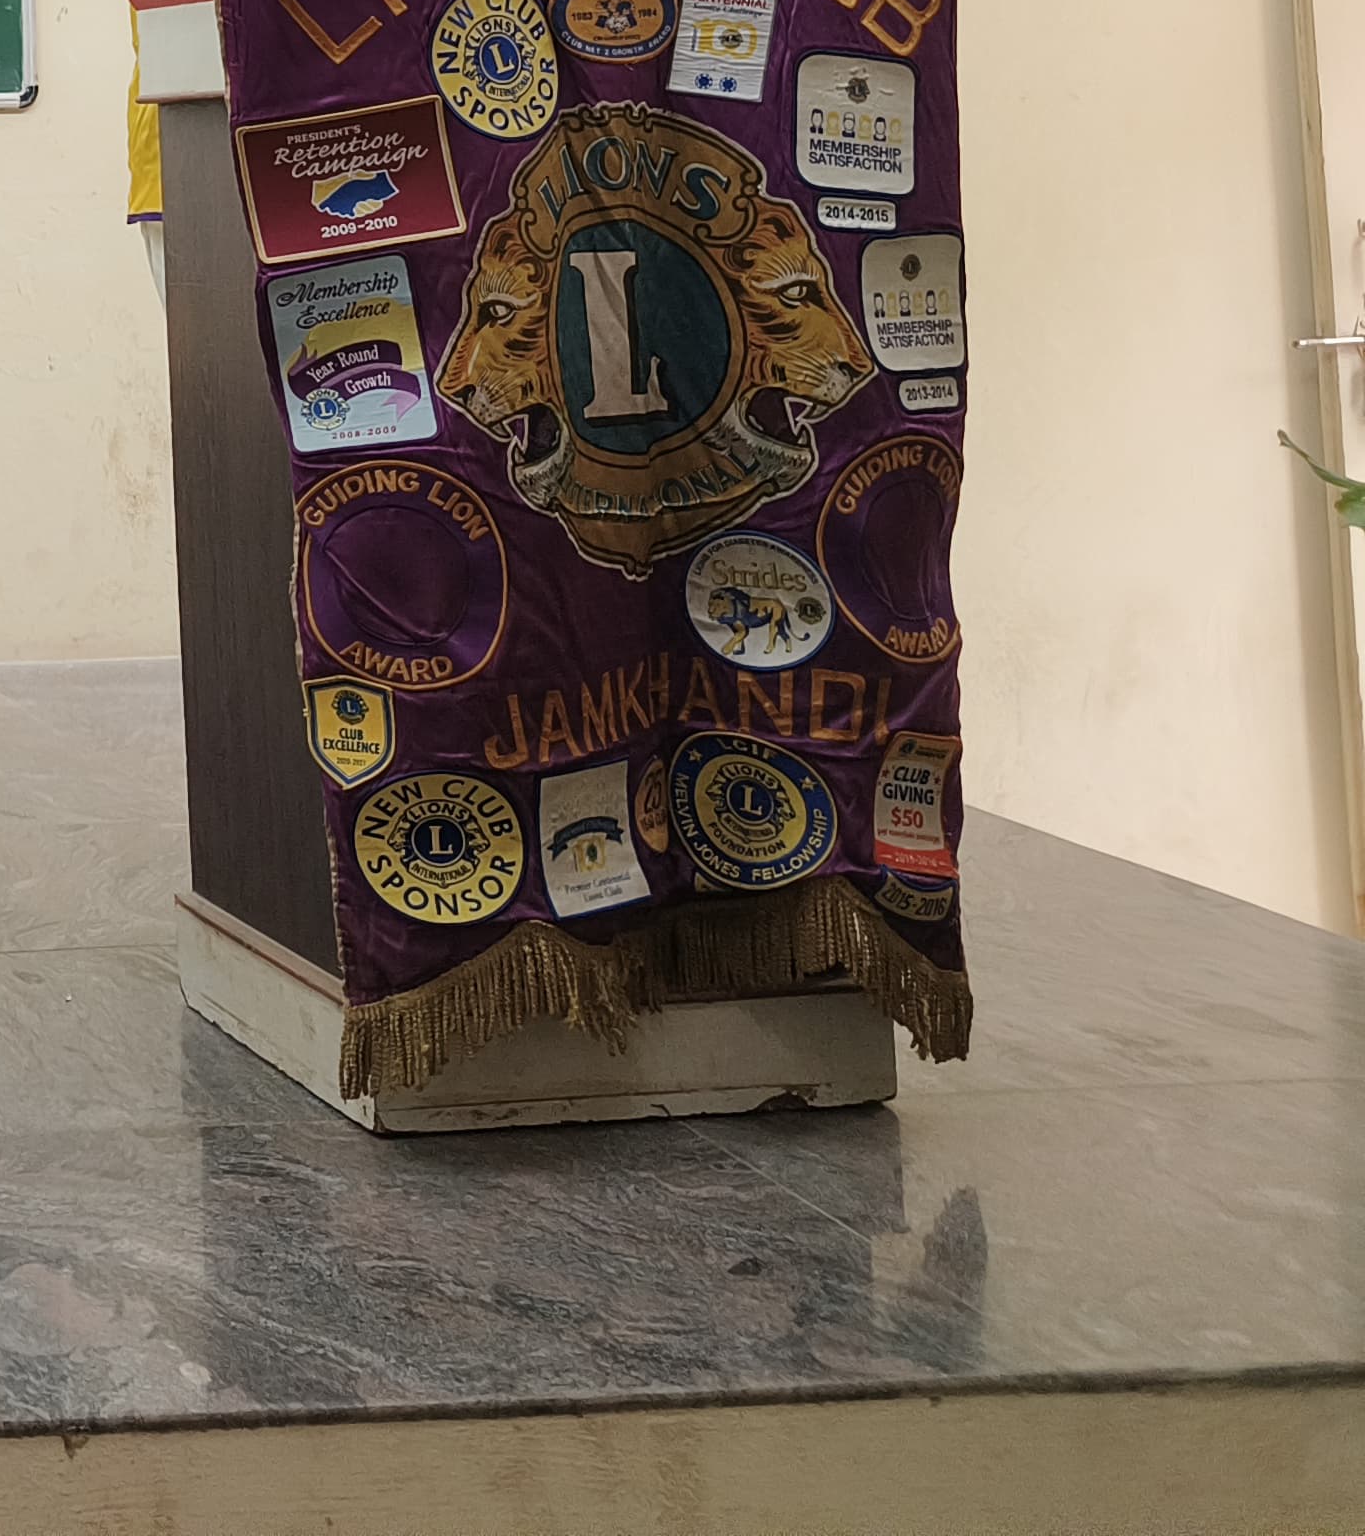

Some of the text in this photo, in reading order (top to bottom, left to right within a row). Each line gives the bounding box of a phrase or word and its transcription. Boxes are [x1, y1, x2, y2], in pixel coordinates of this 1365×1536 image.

[469, 17, 514, 45] LIONS
[488, 41, 516, 76] L
[452, 56, 556, 132] SPONSOR
[273, 130, 406, 166] Retention
[286, 124, 363, 145] PRESIDENT'S
[808, 138, 903, 160] MEMBERSHIP
[290, 144, 429, 179] Campaign
[808, 151, 903, 175] SATISFACTION
[536, 135, 732, 225] LIONS
[320, 215, 399, 240] 2009-2010
[825, 205, 890, 223] 2014-2015
[276, 271, 400, 308] Membership
[295, 300, 391, 330] Excellence
[876, 318, 953, 336] MEMBERSHIP
[569, 249, 671, 424] L
[878, 332, 955, 350] SATISFACTION
[344, 371, 392, 395] Growth
[905, 385, 954, 402] 2013-2014
[319, 402, 333, 417] L
[835, 444, 924, 515] GUIDING
[303, 468, 490, 542] GUIDING LION
[710, 559, 808, 593] Strides
[884, 616, 950, 655] AWARD
[339, 640, 454, 683] AWARD
[345, 699, 356, 713] L
[482, 653, 893, 770] JAMKHANDI
[322, 738, 381, 755] EXCELLENCE
[339, 727, 364, 741] CLUB
[716, 737, 779, 761] LCIF
[728, 764, 777, 789] LIONS
[893, 765, 931, 785] CLUB
[739, 784, 763, 817] L
[882, 782, 935, 806] GIVING
[361, 781, 424, 841] NEW
[441, 779, 514, 837] CLUB
[411, 802, 468, 822] LIONS
[891, 806, 924, 829] $50
[428, 825, 454, 856] L
[674, 771, 829, 882] MELVIN JONES FELLOWSHIP
[708, 821, 787, 858] FOUNDATION
[367, 854, 517, 917] SPONSOR
[411, 863, 472, 883] INTERNATIONAL
[882, 881, 948, 915] 2015-2016
